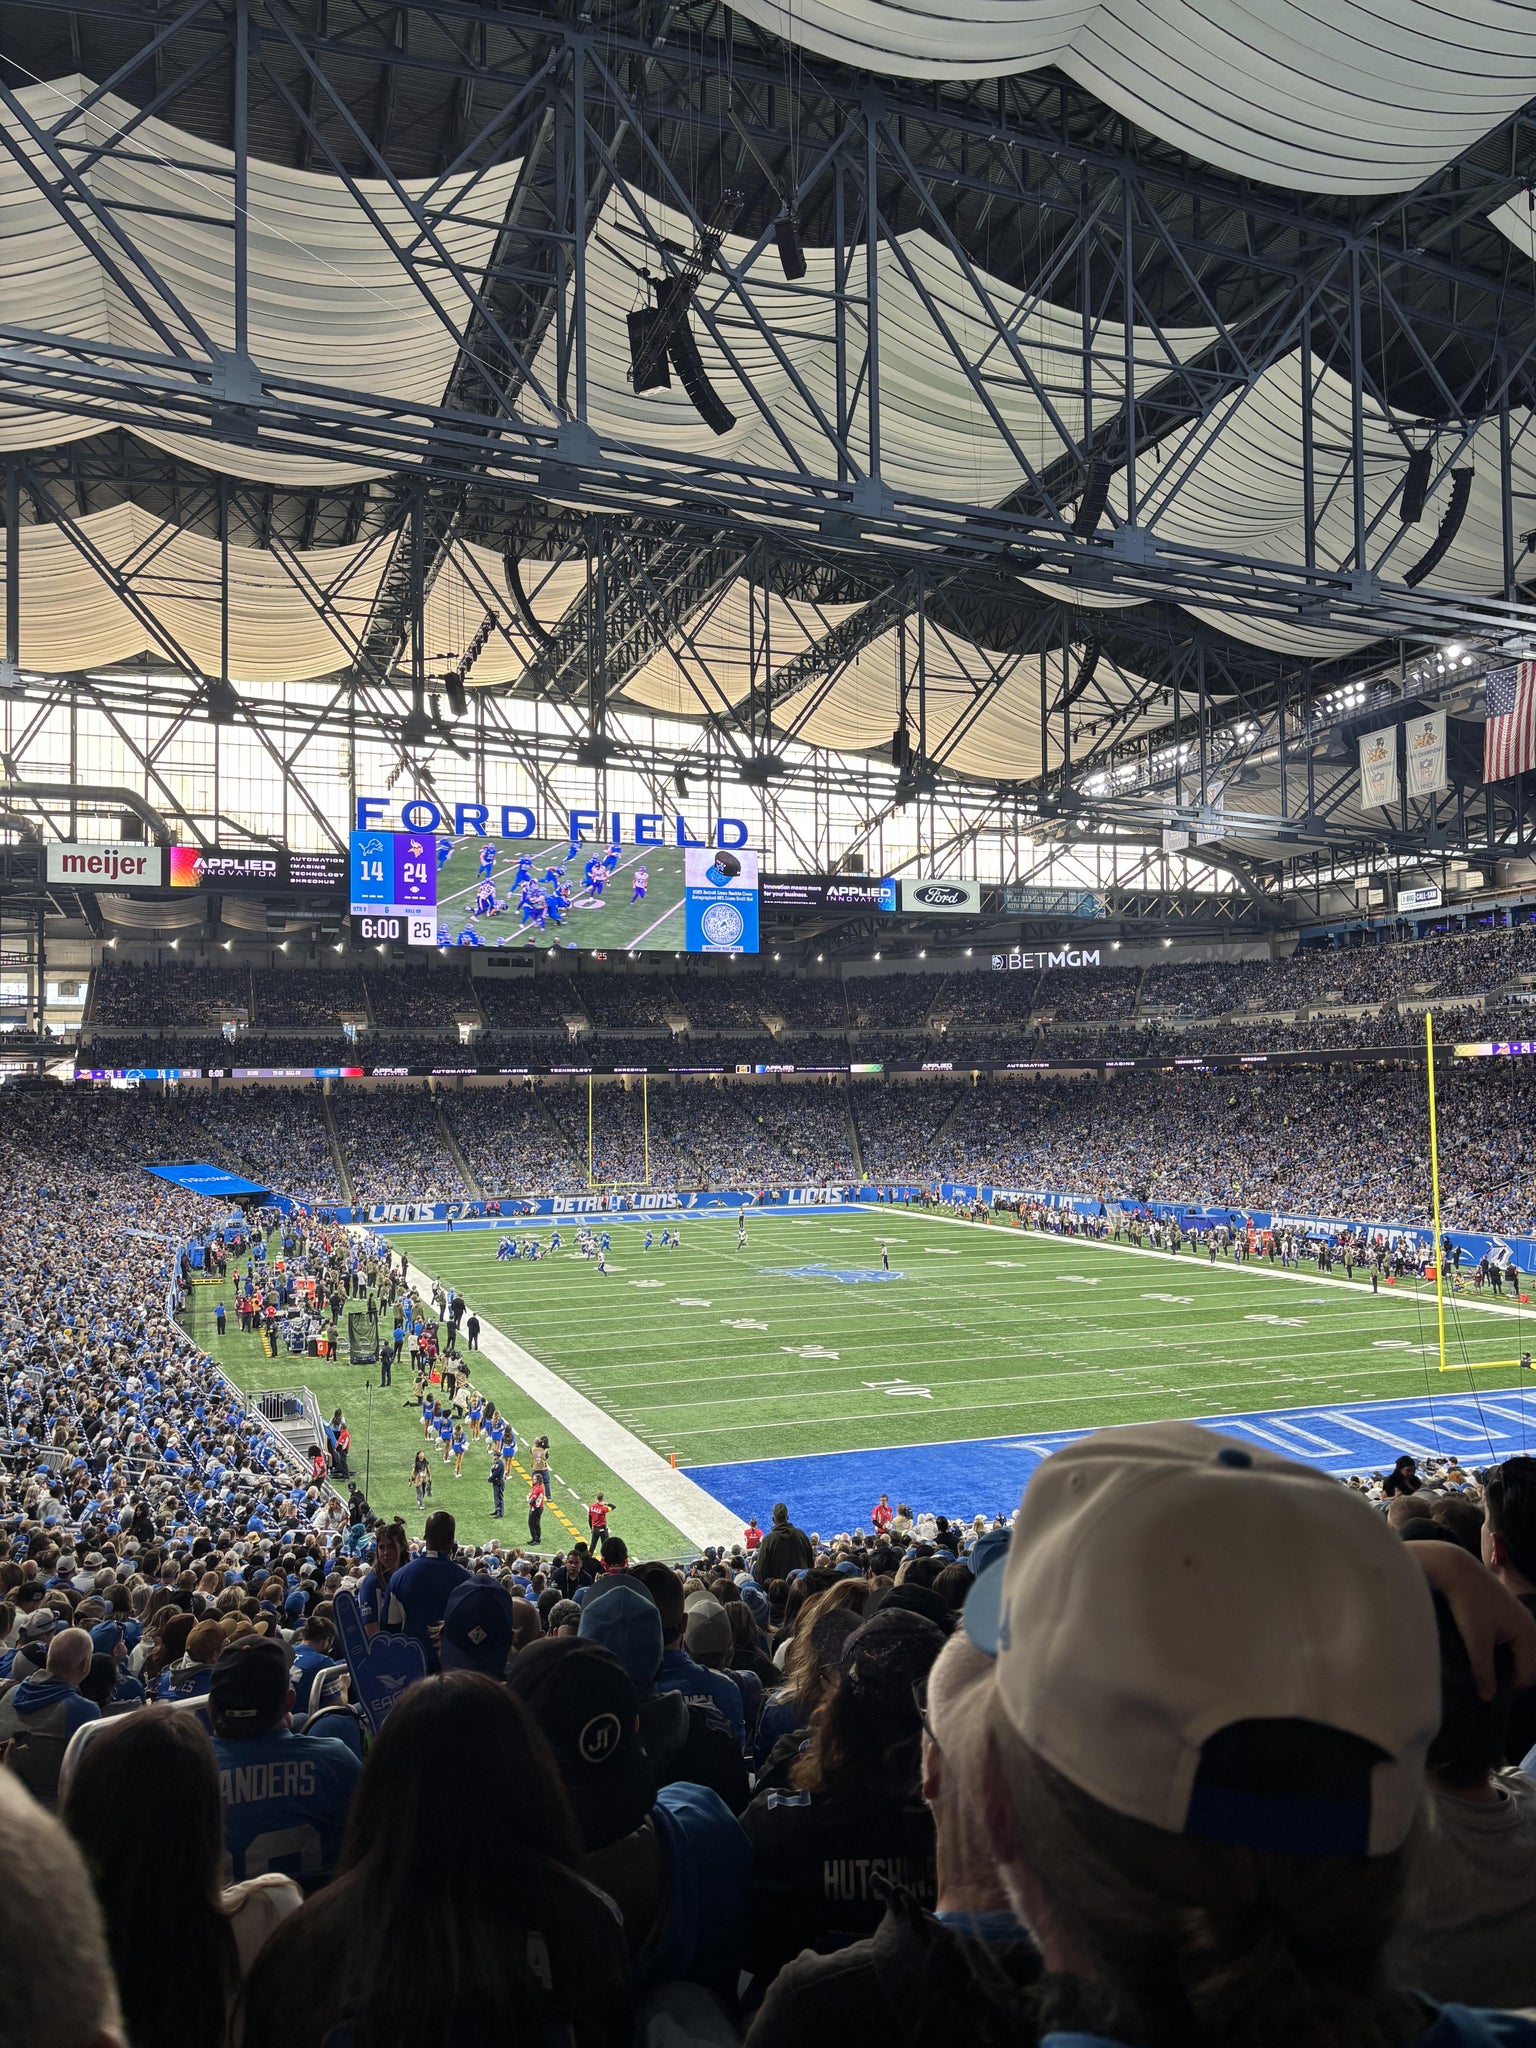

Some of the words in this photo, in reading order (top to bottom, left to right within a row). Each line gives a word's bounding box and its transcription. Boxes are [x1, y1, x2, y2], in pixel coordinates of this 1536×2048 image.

[356, 796, 537, 839] FORD
[568, 809, 749, 849] FIELD
[62, 849, 147, 880] meijer
[192, 857, 276, 871] APPLIED
[290, 856, 345, 864] AUTOMATION
[192, 868, 277, 878] INNOVATION
[290, 870, 345, 878] TECHNOLOGY
[360, 860, 384, 882] 14
[403, 862, 428, 883] 24
[826, 886, 891, 897] APPLIED
[826, 895, 892, 903] INNOVATION
[924, 887, 958, 905] Ford
[361, 918, 399, 939] 6:00
[414, 922, 431, 938] 25
[597, 952, 608, 960] 25
[1009, 950, 1101, 970] BETMGM
[104, 1069, 114, 1079] 24
[157, 1069, 166, 1078] 14
[208, 1069, 224, 1077] 6:00
[631, 1192, 679, 1210] LIONS
[788, 1187, 844, 1205] LIONS
[780, 1344, 840, 1360] 20
[861, 1378, 933, 1399] 10
[219, 1760, 316, 1805] ANDERS
